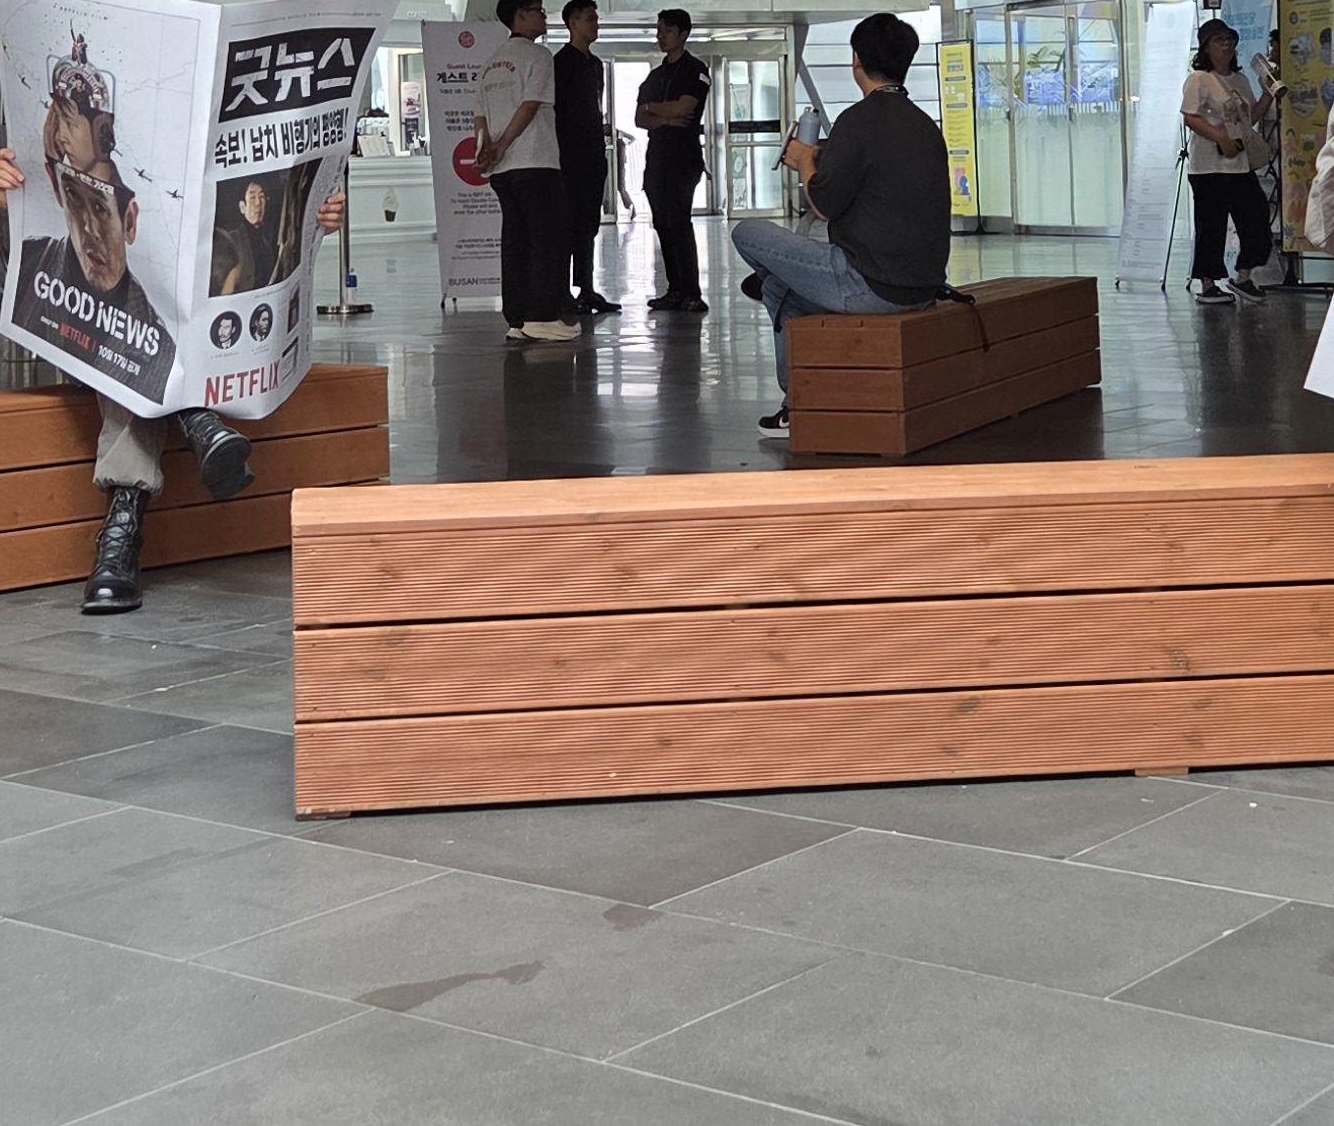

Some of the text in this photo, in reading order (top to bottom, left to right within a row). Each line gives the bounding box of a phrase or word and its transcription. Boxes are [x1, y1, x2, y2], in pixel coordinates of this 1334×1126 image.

[224, 37, 356, 112] 굿뉴스
[214, 107, 349, 169] 속보! 납치 비행기의 평양행!
[33, 270, 160, 357] GOOD NEWS
[58, 321, 92, 350] NETFLIX
[204, 358, 282, 409] NETFLIX
